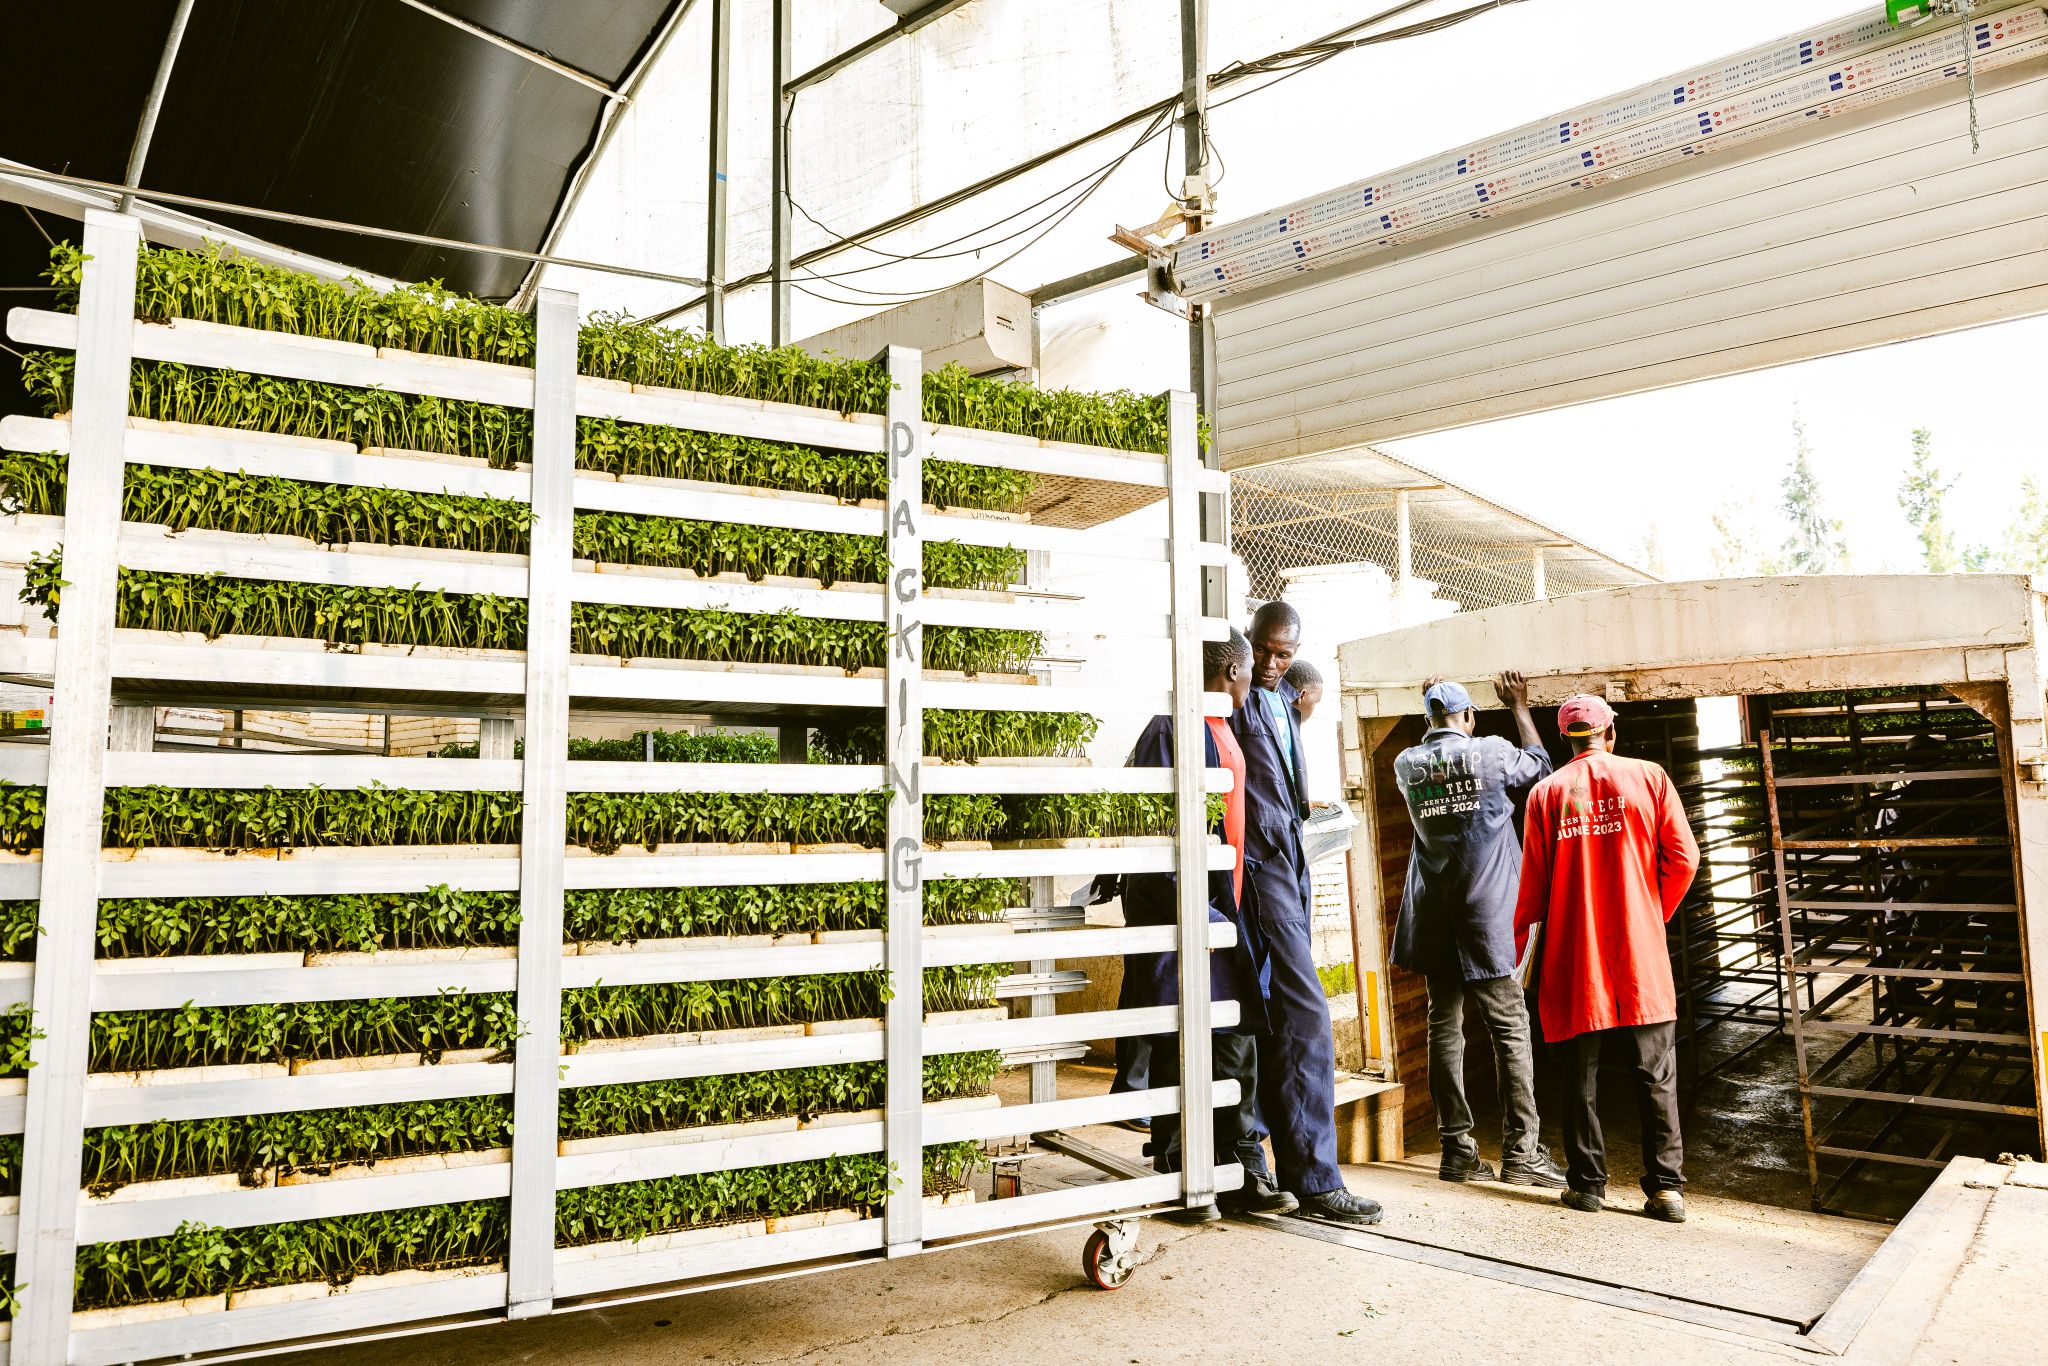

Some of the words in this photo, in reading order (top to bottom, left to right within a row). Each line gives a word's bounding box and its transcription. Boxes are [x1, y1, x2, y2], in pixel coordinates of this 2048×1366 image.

[890, 421, 922, 892] PACKING
[1419, 805, 1447, 819] JUNE
[1452, 800, 1481, 813] 2024
[1424, 796, 1450, 807] KENYA
[1452, 794, 1471, 802] LTD.
[1557, 824, 1590, 841] JUNE
[1592, 820, 1622, 836] 2023
